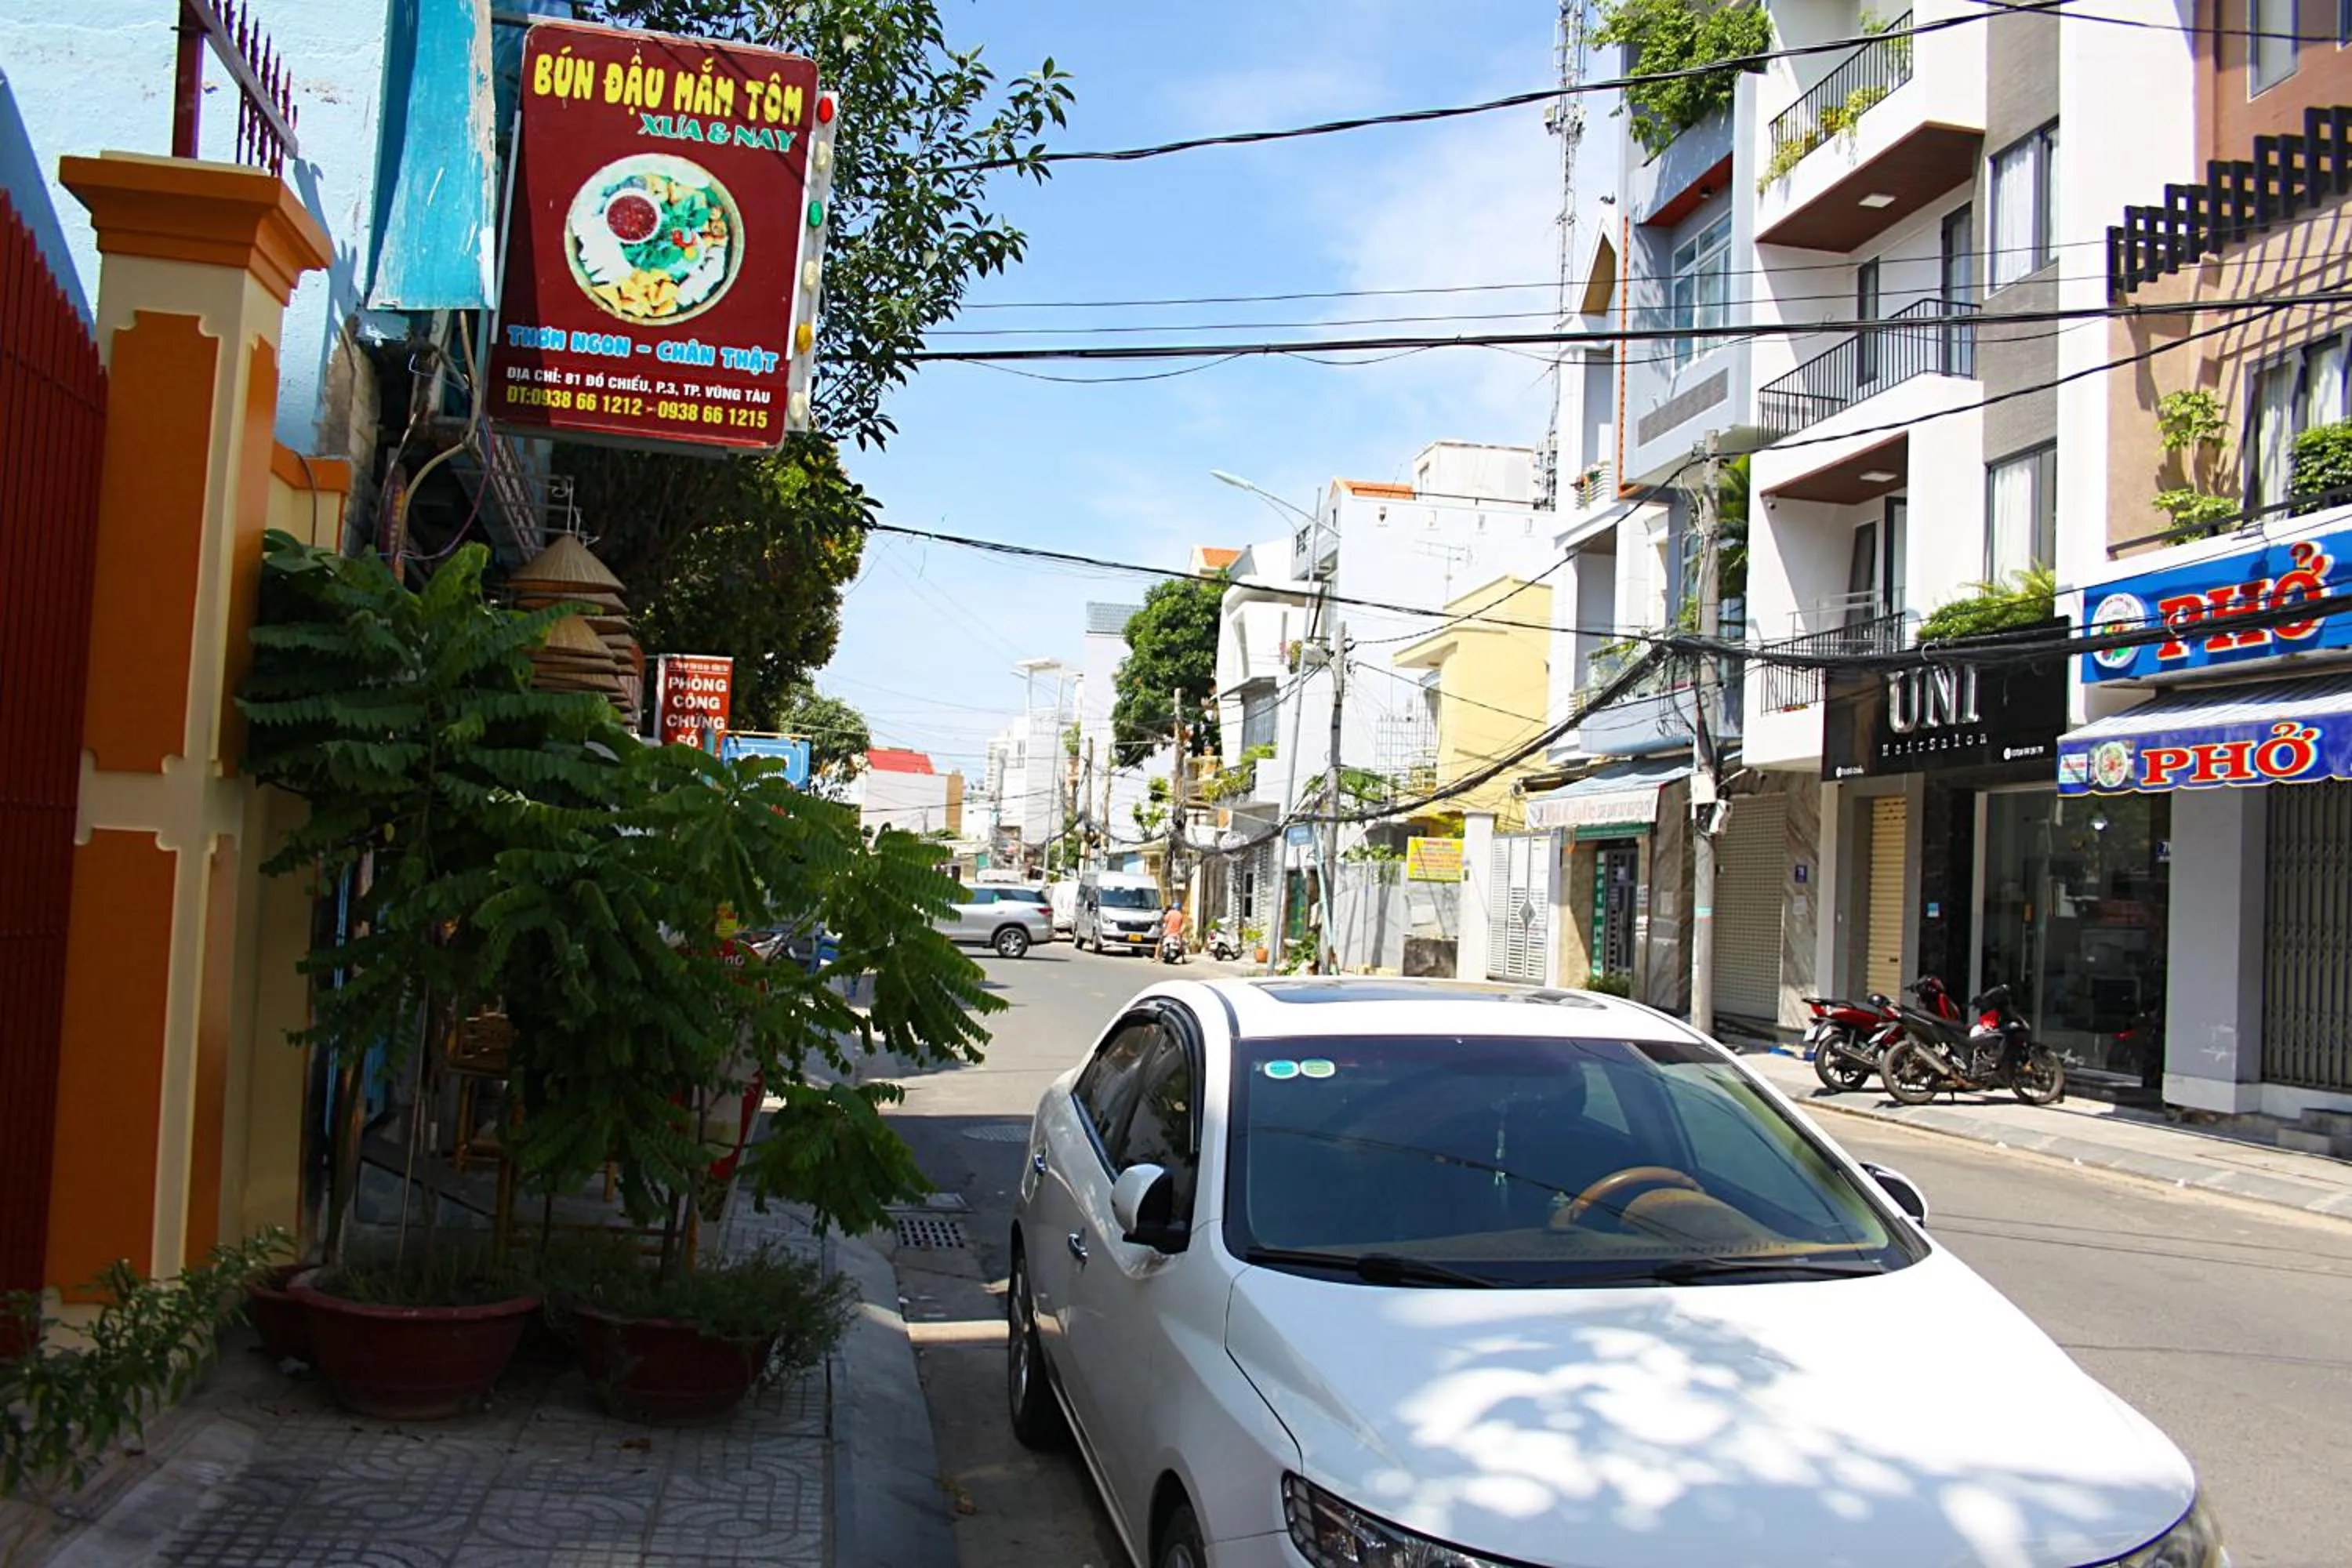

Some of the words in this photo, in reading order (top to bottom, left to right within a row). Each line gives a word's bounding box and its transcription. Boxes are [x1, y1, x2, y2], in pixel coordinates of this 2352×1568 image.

[534, 45, 595, 100] BÚN
[602, 54, 665, 116] ĐẬU
[673, 56, 735, 118] MẮM
[746, 72, 803, 126] TÔM
[637, 112, 704, 142] XƯA
[707, 122, 731, 144] &
[734, 125, 797, 153] NAY
[507, 325, 566, 351] THƠM
[571, 331, 631, 358] NGON
[656, 338, 716, 366] CHÂN
[720, 345, 779, 376] THẬT
[565, 372, 580, 385] 81
[705, 384, 741, 401] VŨNG
[744, 388, 771, 404] TÀU
[576, 392, 597, 412] 66
[603, 395, 643, 416] 1212
[657, 400, 699, 421] 0938
[702, 405, 724, 424] 66
[729, 408, 768, 429] 1215
[2157, 541, 2333, 662] PHỞ
[668, 673, 728, 692] PHÒNG
[672, 692, 720, 710] CÔNG
[1886, 664, 1983, 733] UNI
[666, 713, 726, 730] CHỨNG
[2140, 721, 2322, 786] PHỞ
